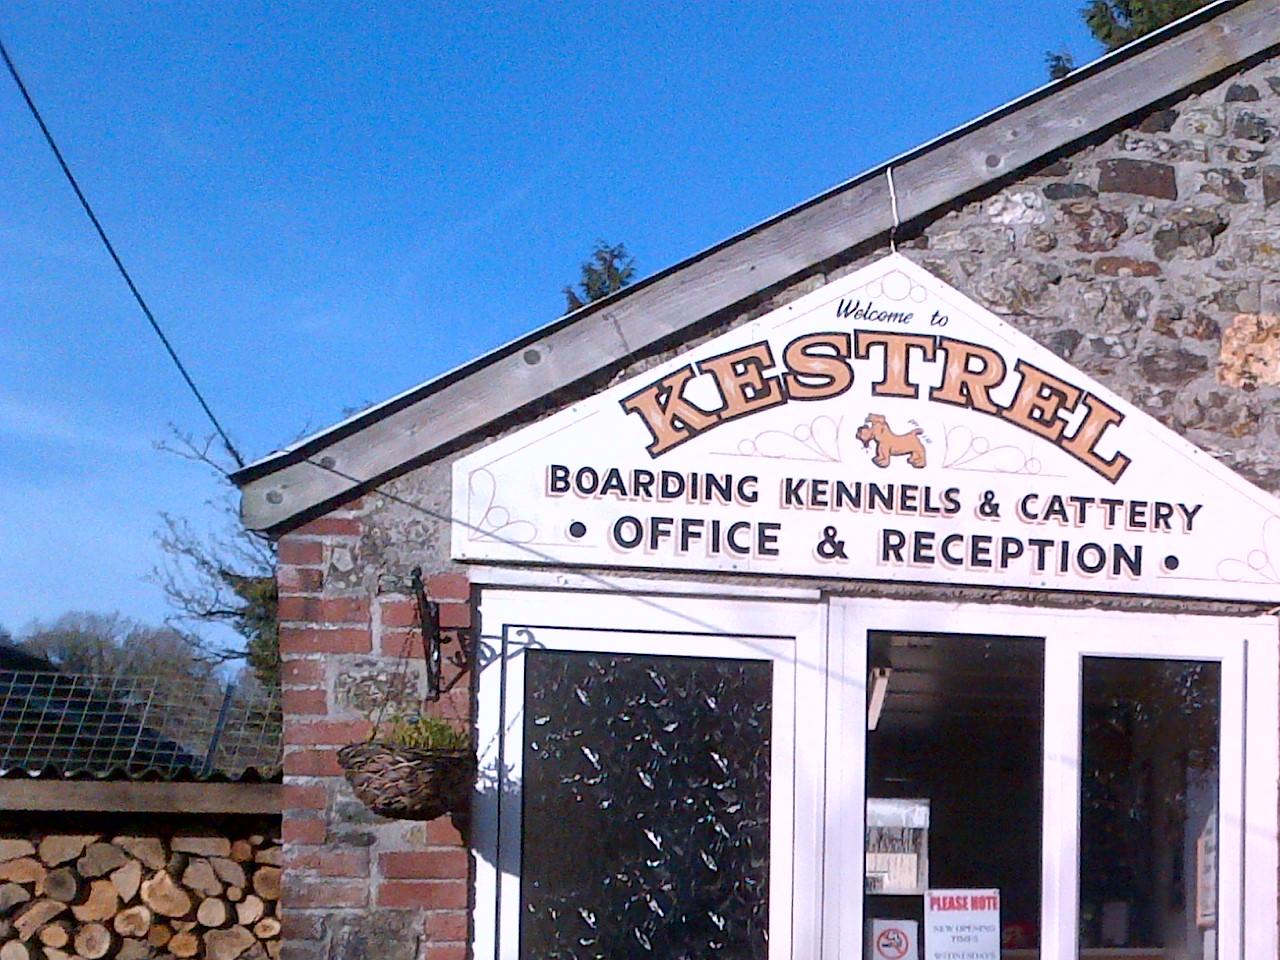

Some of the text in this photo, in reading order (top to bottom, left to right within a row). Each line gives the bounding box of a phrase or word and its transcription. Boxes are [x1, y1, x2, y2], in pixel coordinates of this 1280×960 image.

[836, 298, 950, 328] Welcome to
[619, 329, 1131, 485] KESTREL
[550, 464, 1203, 532] BOARDING KENNELS & CATTERY
[613, 515, 1143, 577] OFFICE & RECEPTION
[930, 896, 998, 911] PLEASE NOTE
